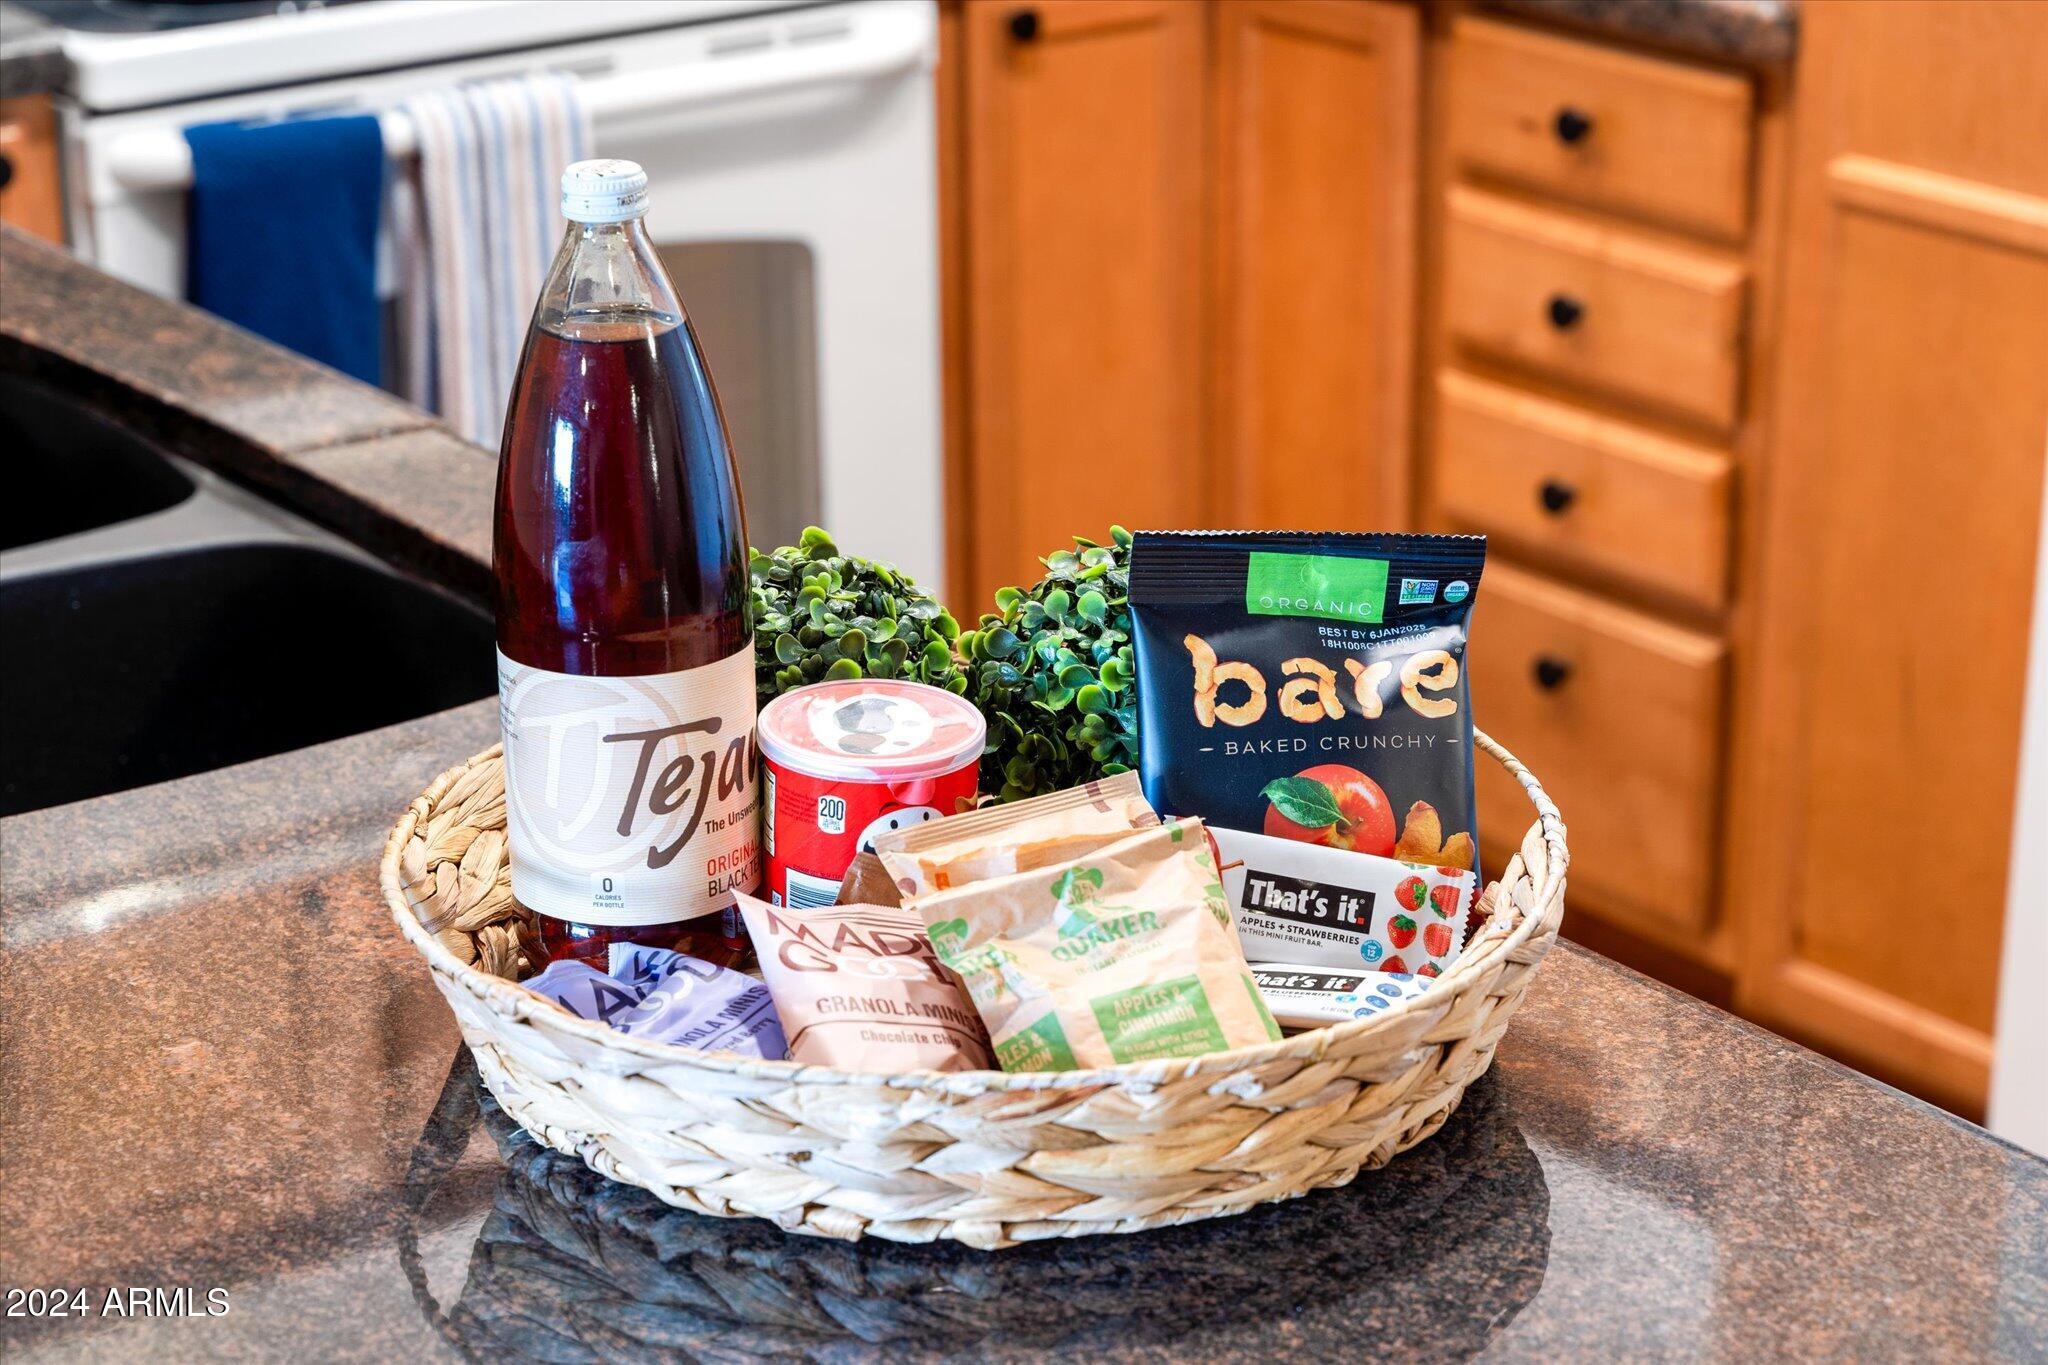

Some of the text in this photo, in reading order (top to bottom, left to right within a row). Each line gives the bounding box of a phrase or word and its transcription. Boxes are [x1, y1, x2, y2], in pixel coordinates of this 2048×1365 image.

[1258, 596, 1373, 616] ORGANIC
[1318, 626, 1348, 637] BEST
[1351, 630, 1366, 639] BY
[1183, 633, 1459, 728] bare
[1225, 734, 1437, 756] BAKED CRUNCHY
[705, 819, 725, 834] The
[728, 799, 759, 826] Unswee
[820, 798, 844, 821] 200
[603, 877, 613, 893] 0
[709, 864, 748, 898] BLACK
[749, 855, 760, 876] TE
[1249, 879, 1365, 925] That's it.
[1051, 911, 1161, 962] QUAKER
[1240, 916, 1276, 930] APPLES
[1279, 923, 1285, 931] +
[1287, 924, 1360, 945] STRAWBERRIES
[1248, 928, 1265, 937] THIS
[1265, 931, 1283, 940] MINI
[1284, 933, 1306, 944] FRUIT
[667, 1019, 723, 1048] NOLA
[718, 985, 769, 1021] MINIS
[816, 996, 978, 1034] GRANOLA MINIS
[1113, 988, 1171, 1017] APPLES
[1118, 1003, 1198, 1036] CINNAMON
[860, 1029, 962, 1049] Chocolate Chip
